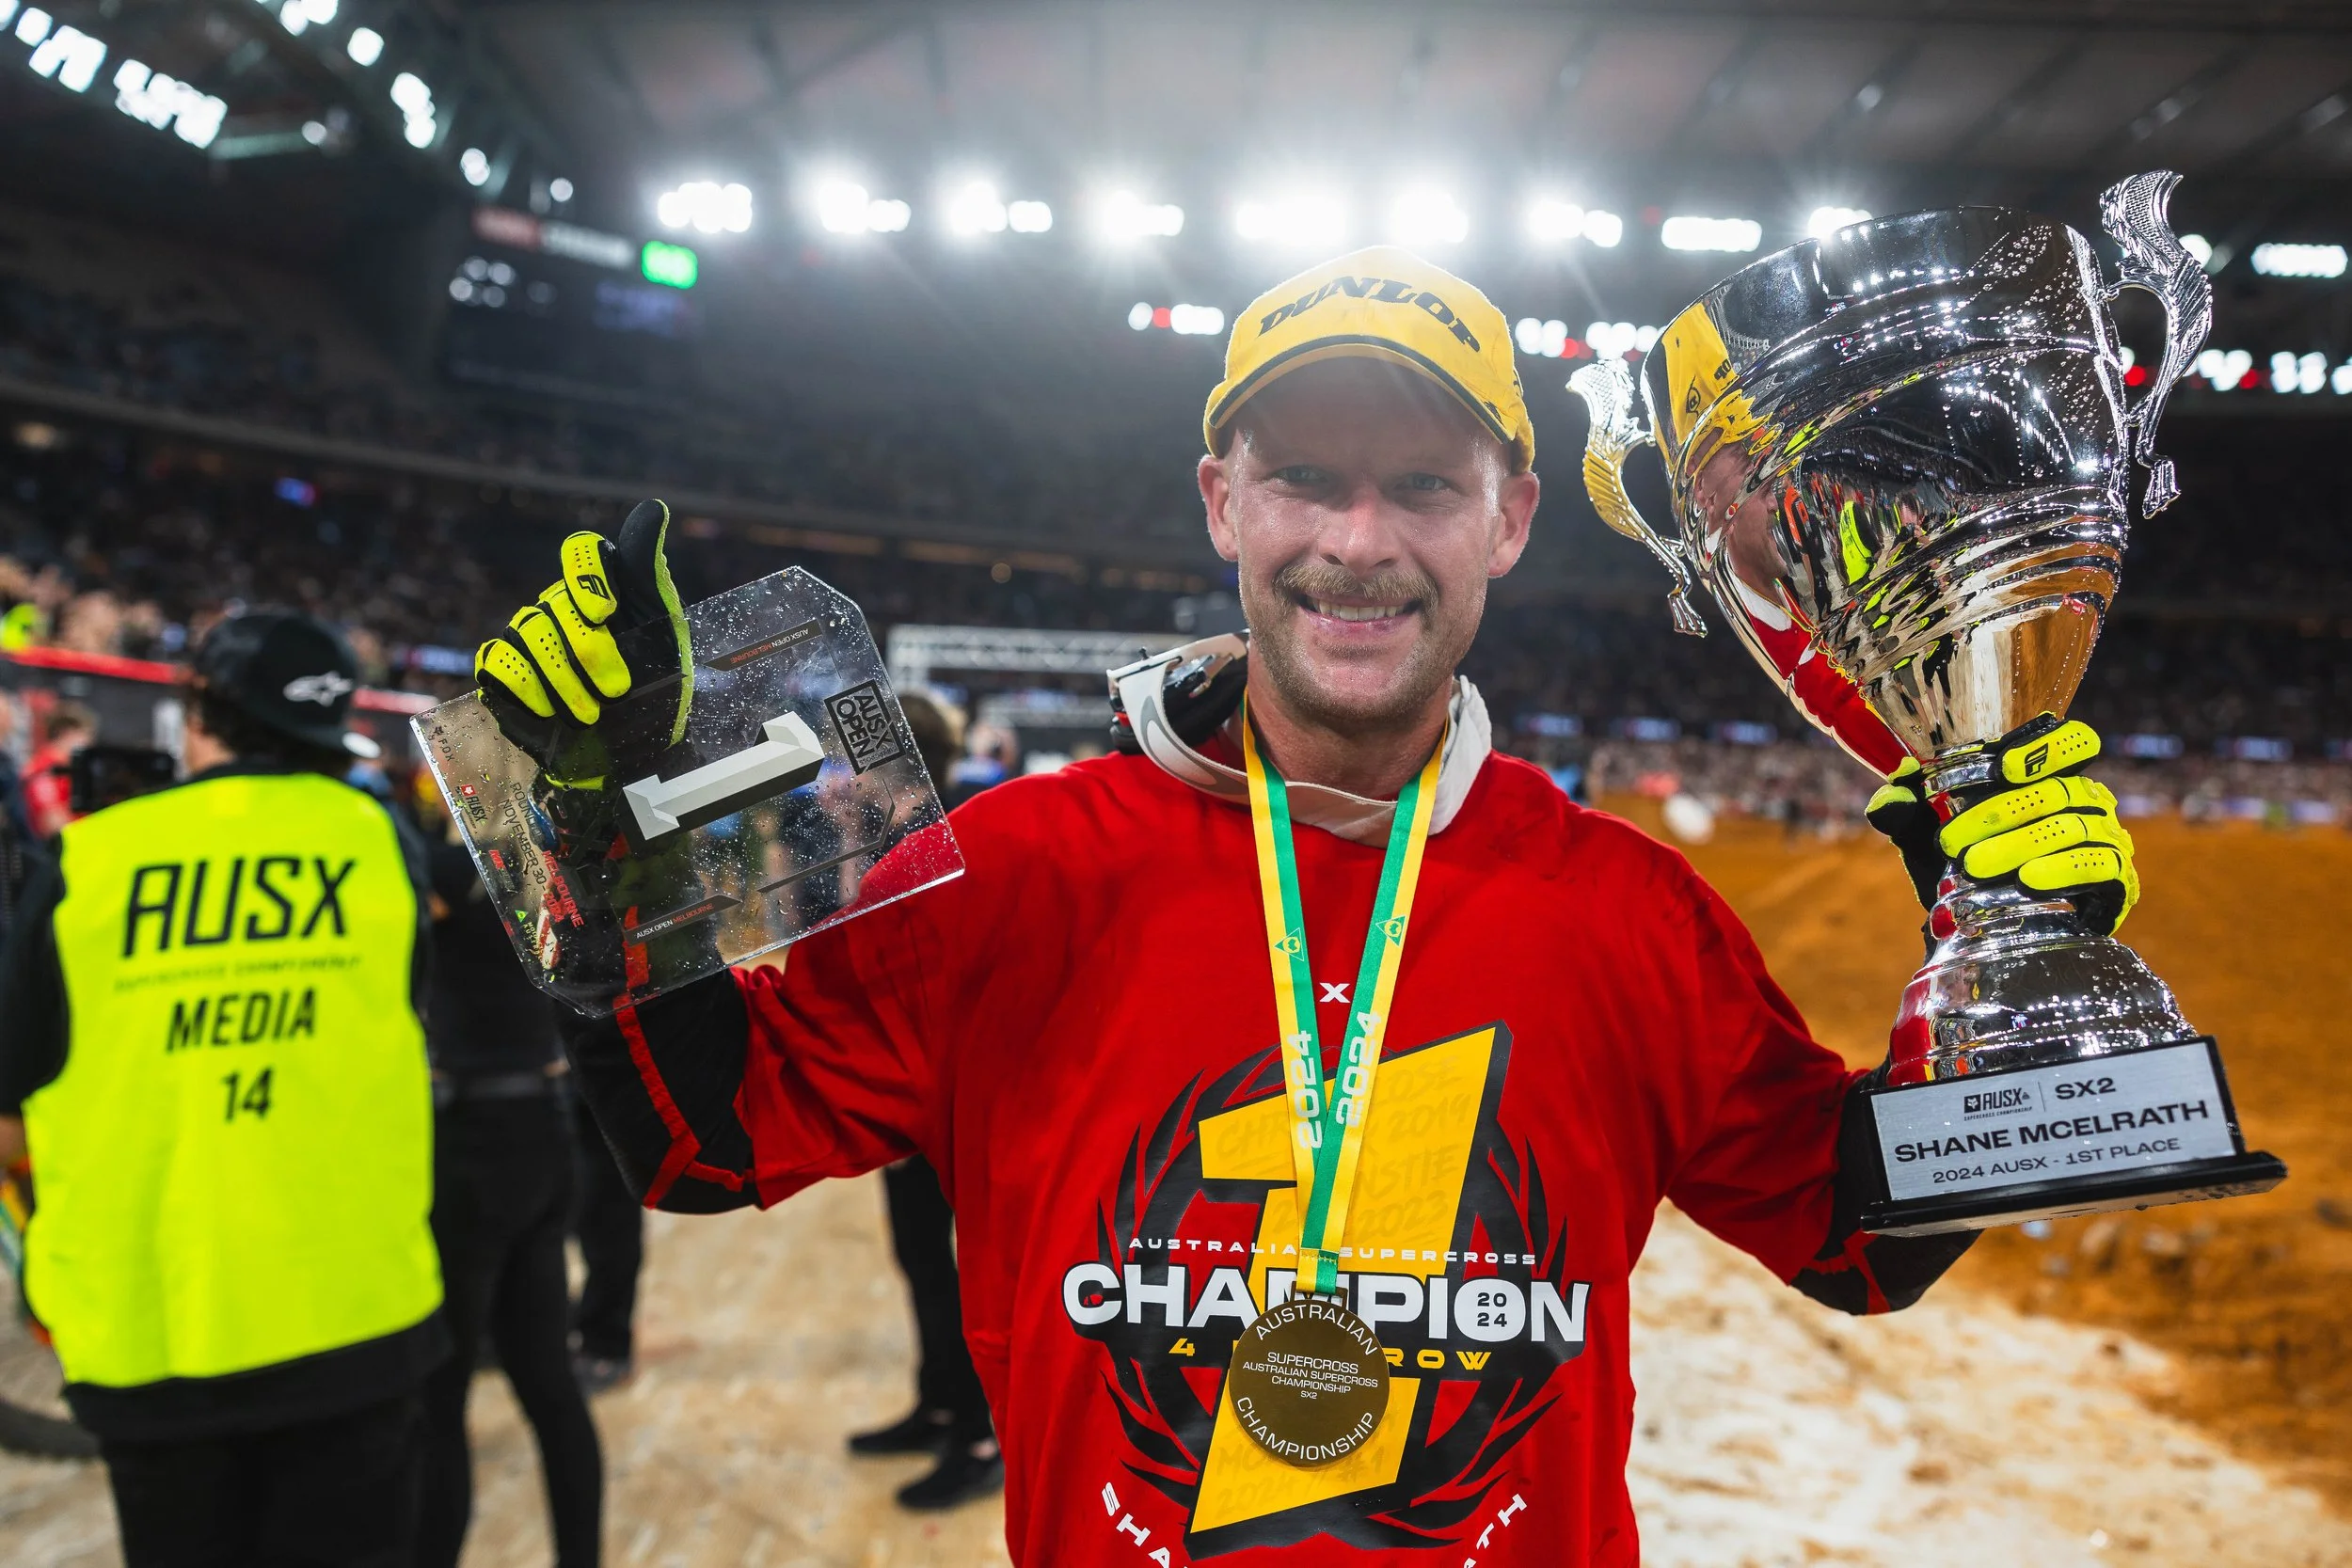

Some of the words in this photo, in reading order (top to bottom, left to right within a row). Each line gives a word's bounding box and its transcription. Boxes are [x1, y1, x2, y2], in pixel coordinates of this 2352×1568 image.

[1256, 276, 1481, 353] DUNLOP
[729, 642, 771, 664] MELBOURNE
[771, 635, 791, 648] OPEN
[791, 628, 809, 641] AUSX
[836, 699, 875, 758] OPEN
[853, 695, 893, 750] AUSX
[438, 738, 455, 762] FOX
[623, 711, 825, 840] 1
[466, 796, 488, 822] AUSX
[501, 798, 539, 869] NOVEMBER
[532, 867, 548, 885] 30
[121, 854, 358, 959] AUSX
[542, 849, 584, 928] MELBOURNE
[636, 927, 655, 939] AUSX
[654, 920, 674, 932] OPEN
[673, 903, 714, 924] MELBOURNE
[165, 985, 318, 1054] MEDIA
[1287, 1030, 1323, 1149] 2024
[1336, 1010, 1382, 1128] 2024
[2055, 1078, 2116, 1101] SX2
[220, 1067, 276, 1122] 14
[1982, 1087, 2022, 1111] AUSX
[1894, 1130, 2012, 1163] SHANE
[2019, 1100, 2209, 1145] MCELRATH
[1932, 1167, 1985, 1184] 2024
[1990, 1157, 2049, 1176] AUSX
[2066, 1148, 2106, 1165] 1ST
[2110, 1138, 2181, 1160] PLACE
[1129, 1238, 1296, 1256] AUSTRALIA
[1339, 1246, 1536, 1265] SUPERCROSS
[1477, 1291, 1507, 1307] 20
[1477, 1312, 1508, 1327] 24
[1255, 1304, 1377, 1355] AUSTRALIAN
[1168, 1338, 1196, 1356] 4
[1382, 1347, 1492, 1370] ROW
[1243, 1361, 1308, 1378] AUSTRALIAN
[1311, 1370, 1378, 1387] SUPERCROSS
[1267, 1352, 1359, 1374] SUPERCROSS
[1271, 1375, 1351, 1393] CHAMPIONSHIP
[1300, 1390, 1318, 1400] SX2
[1237, 1397, 1374, 1461] CHAMPIONSHIP
[1101, 1481, 1188, 1568] SHA
